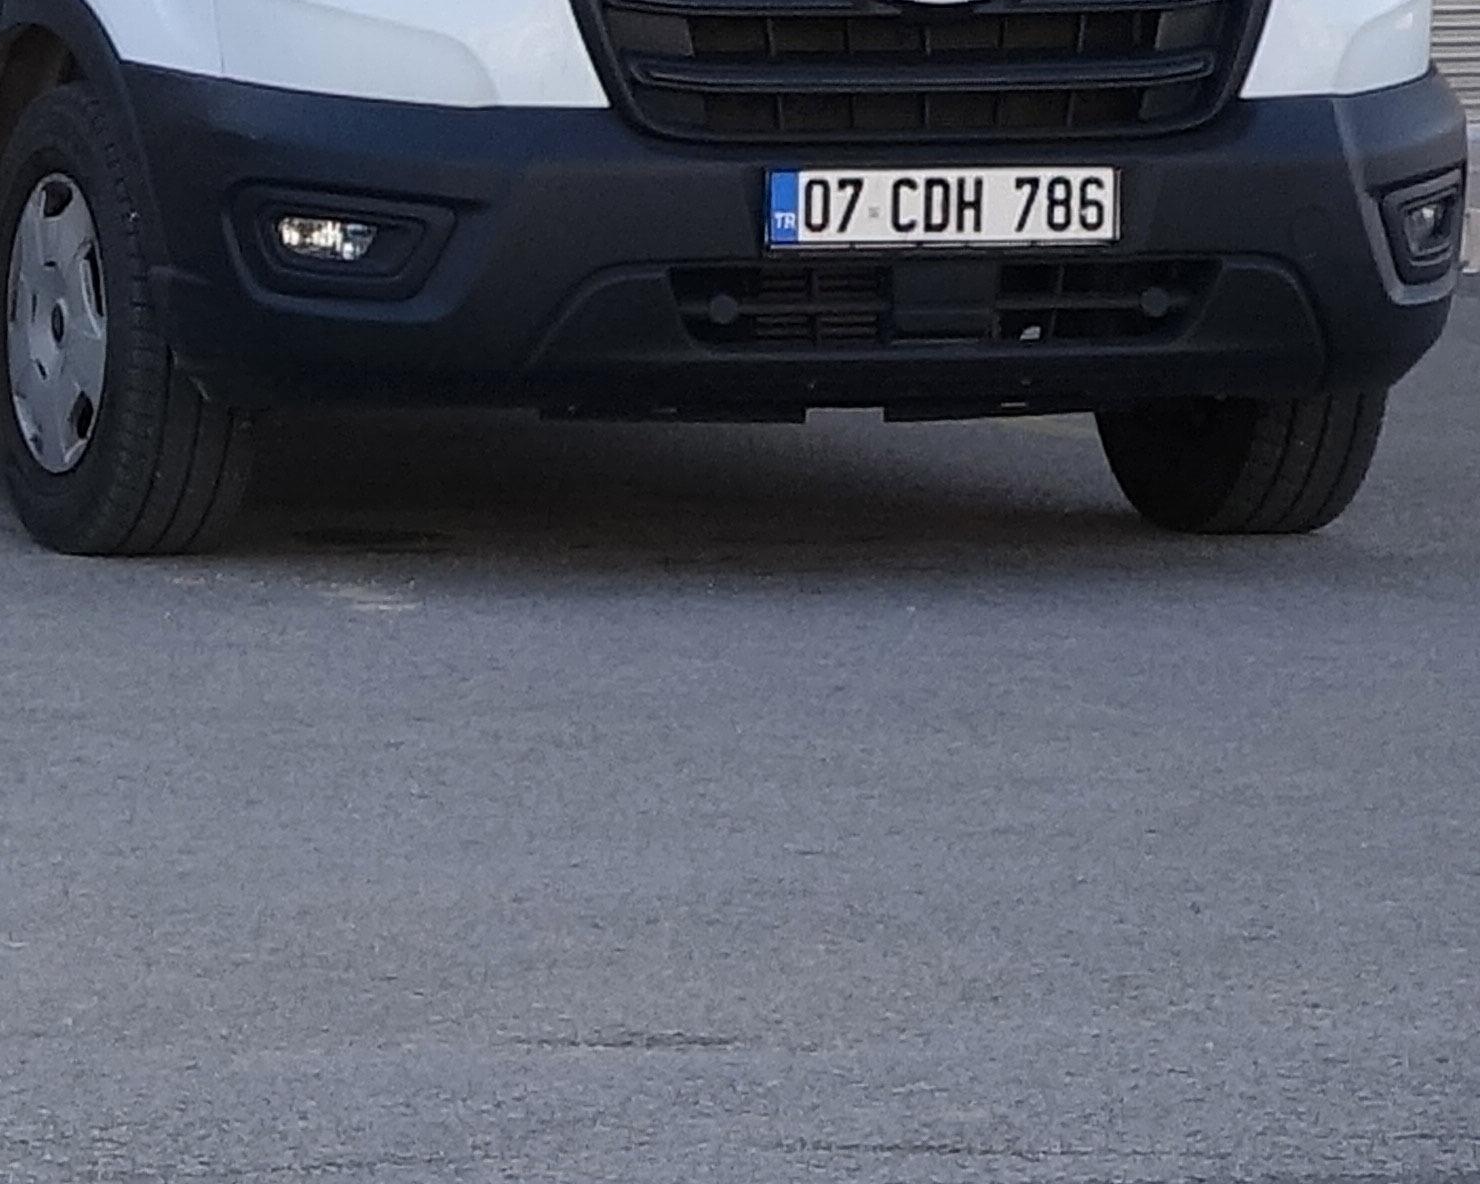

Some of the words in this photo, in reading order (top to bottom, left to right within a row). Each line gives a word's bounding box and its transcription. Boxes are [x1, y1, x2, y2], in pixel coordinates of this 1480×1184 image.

[775, 212, 796, 230] TR
[805, 176, 864, 233] 07
[890, 176, 984, 233] CDH
[1014, 175, 1106, 233] 786
